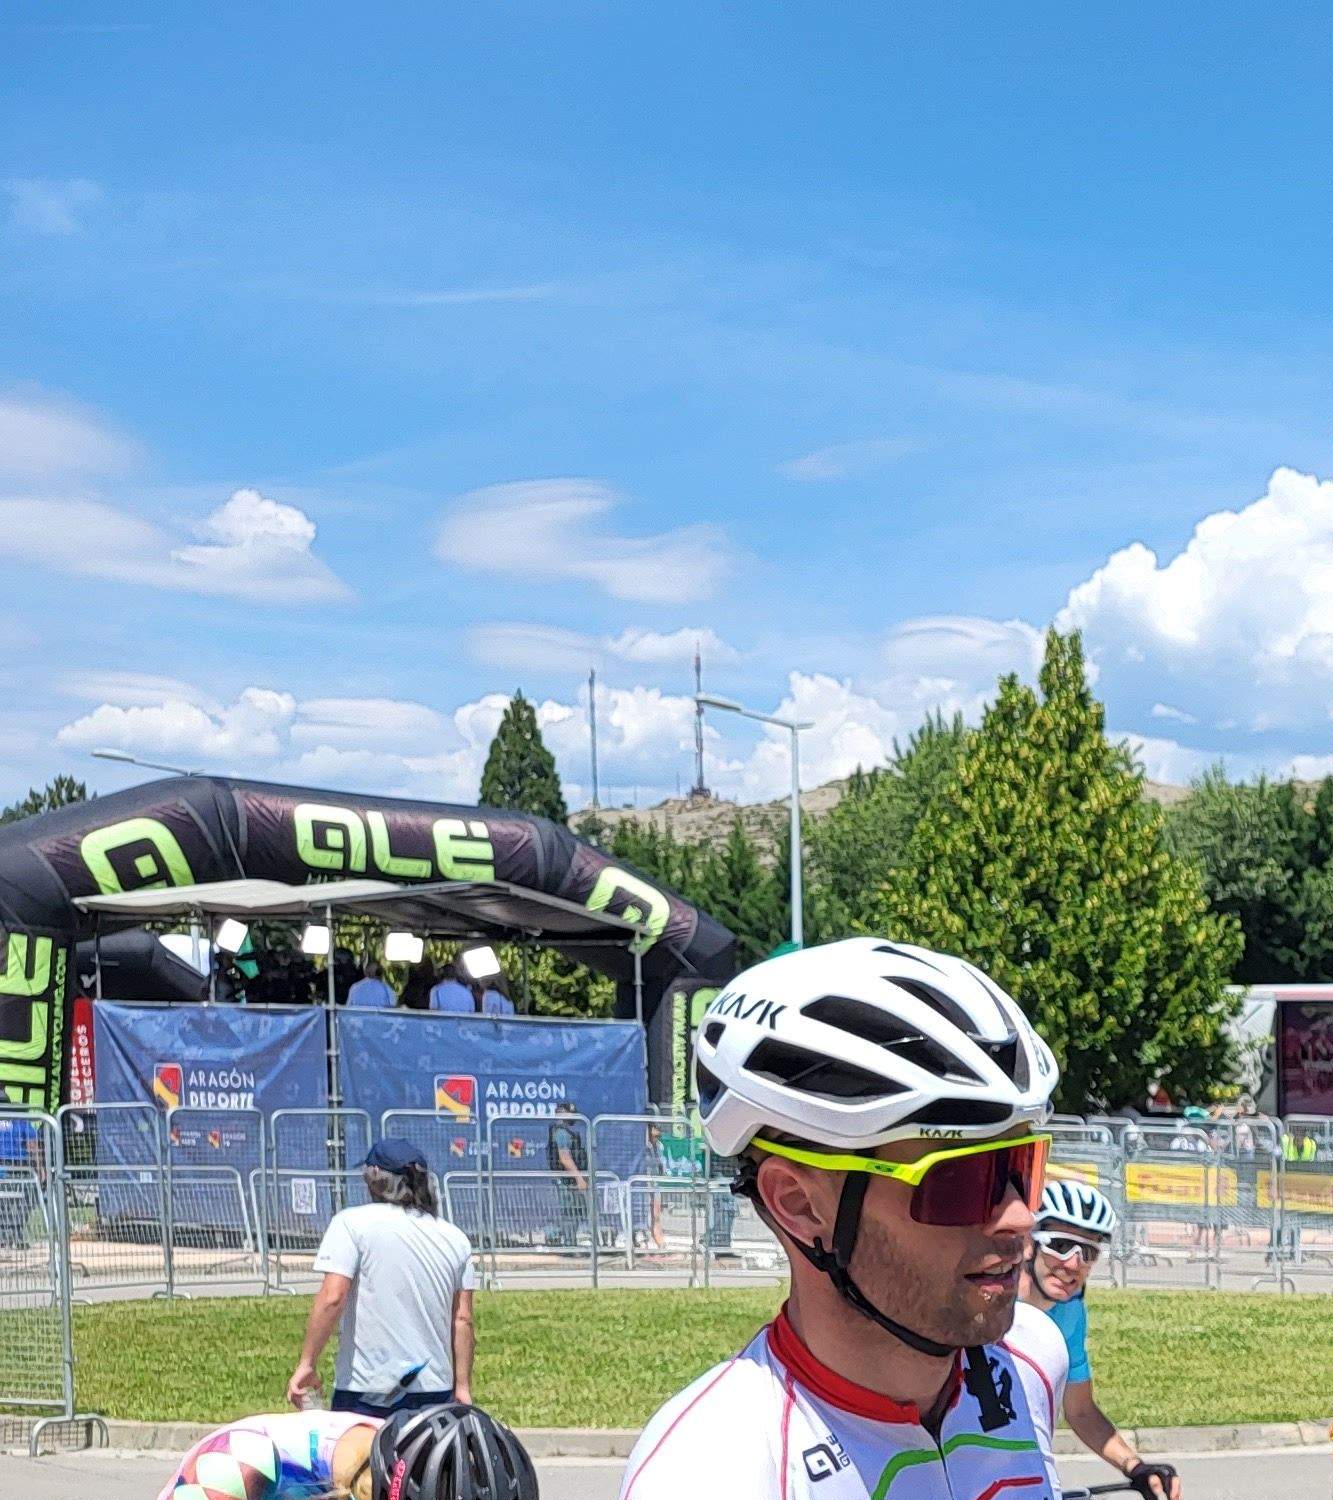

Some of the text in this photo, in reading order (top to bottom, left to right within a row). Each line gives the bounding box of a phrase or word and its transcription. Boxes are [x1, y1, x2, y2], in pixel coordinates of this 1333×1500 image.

[710, 992, 788, 1031] KASK
[188, 1067, 255, 1089] ARAGÓN
[486, 1078, 566, 1099] ARAGÓN
[189, 1092, 255, 1109] DEPORTE
[486, 1102, 558, 1117] DEPORT
[920, 1127, 964, 1139] KASK
